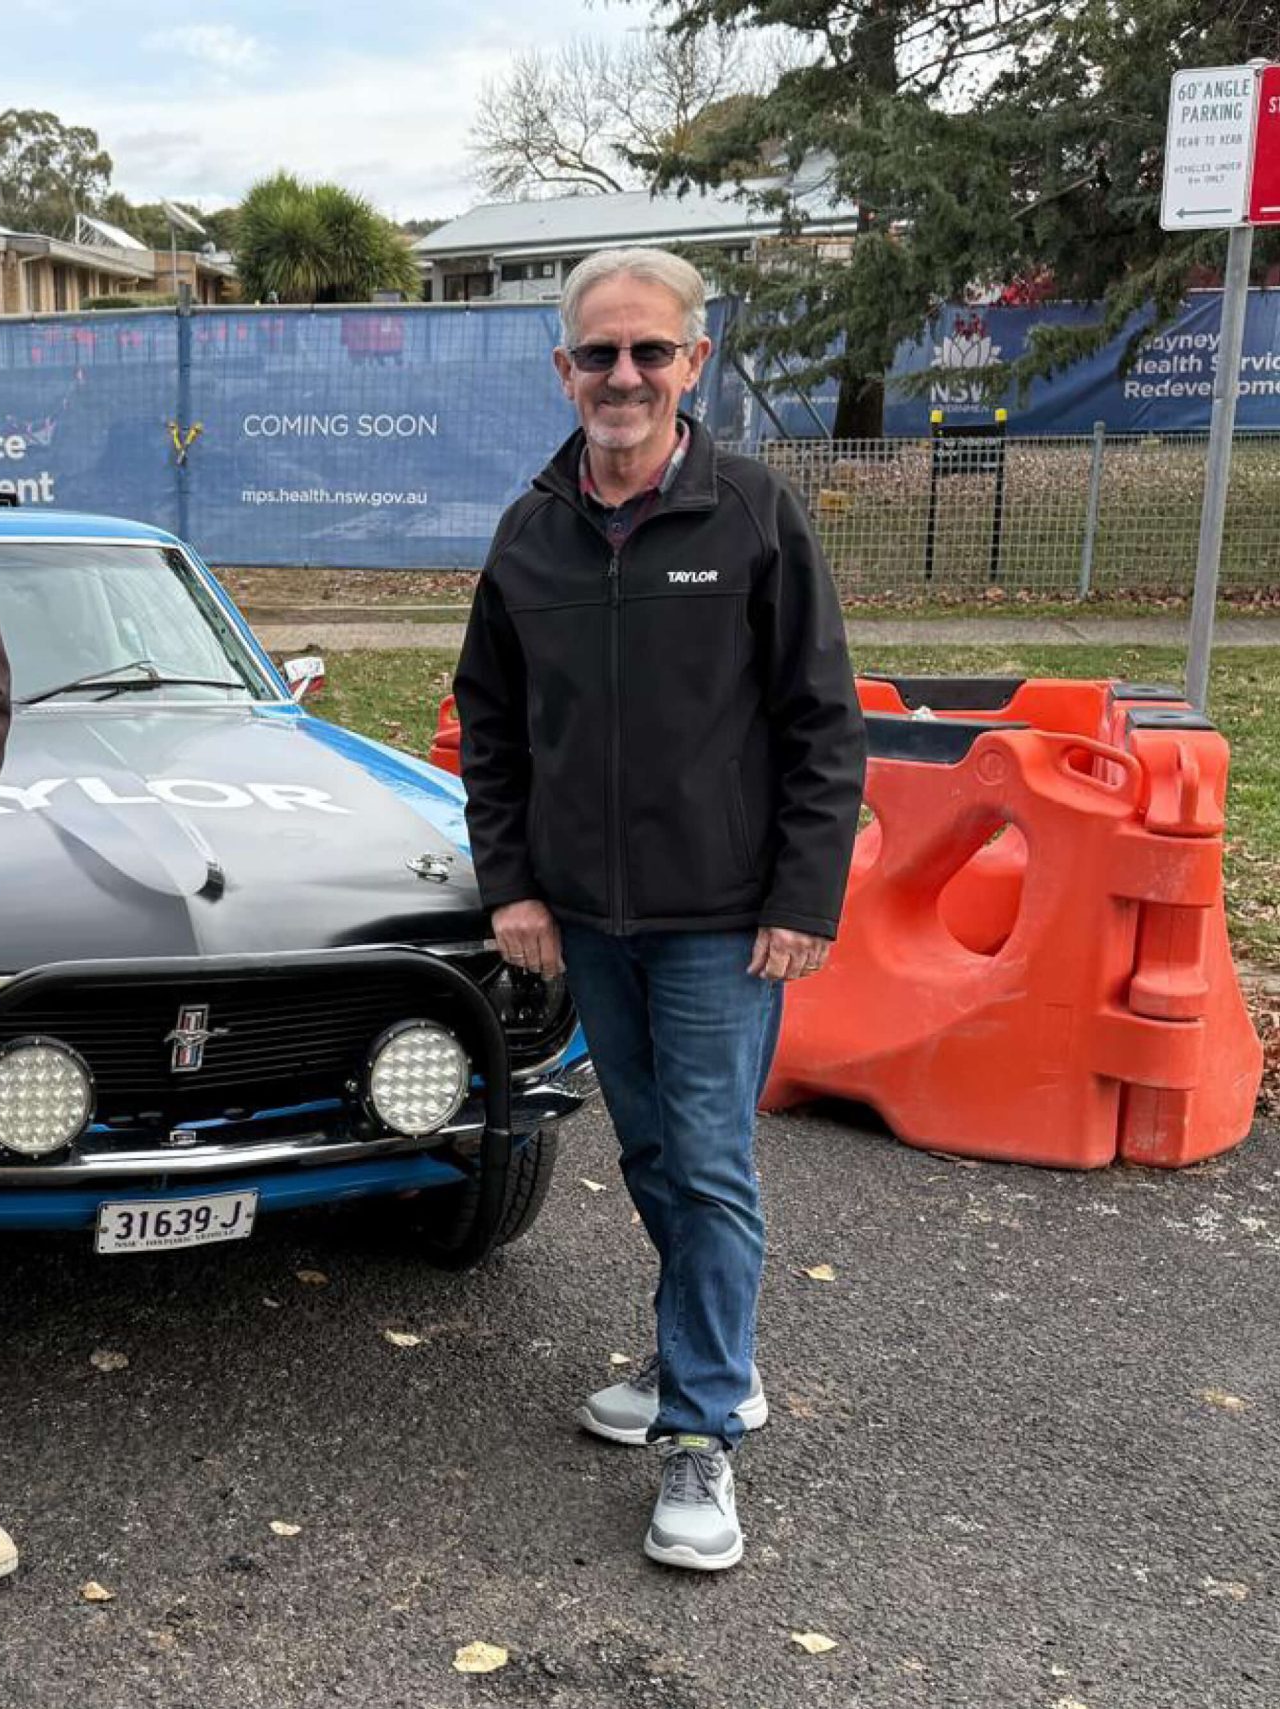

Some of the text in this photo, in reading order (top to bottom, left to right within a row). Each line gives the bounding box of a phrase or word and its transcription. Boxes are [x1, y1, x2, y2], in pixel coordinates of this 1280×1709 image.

[1182, 102, 1242, 123] PARKING
[243, 414, 438, 436] COMING SOON
[241, 489, 428, 507] mps.health.nsw.gov.au
[666, 570, 719, 583] TAYLOR
